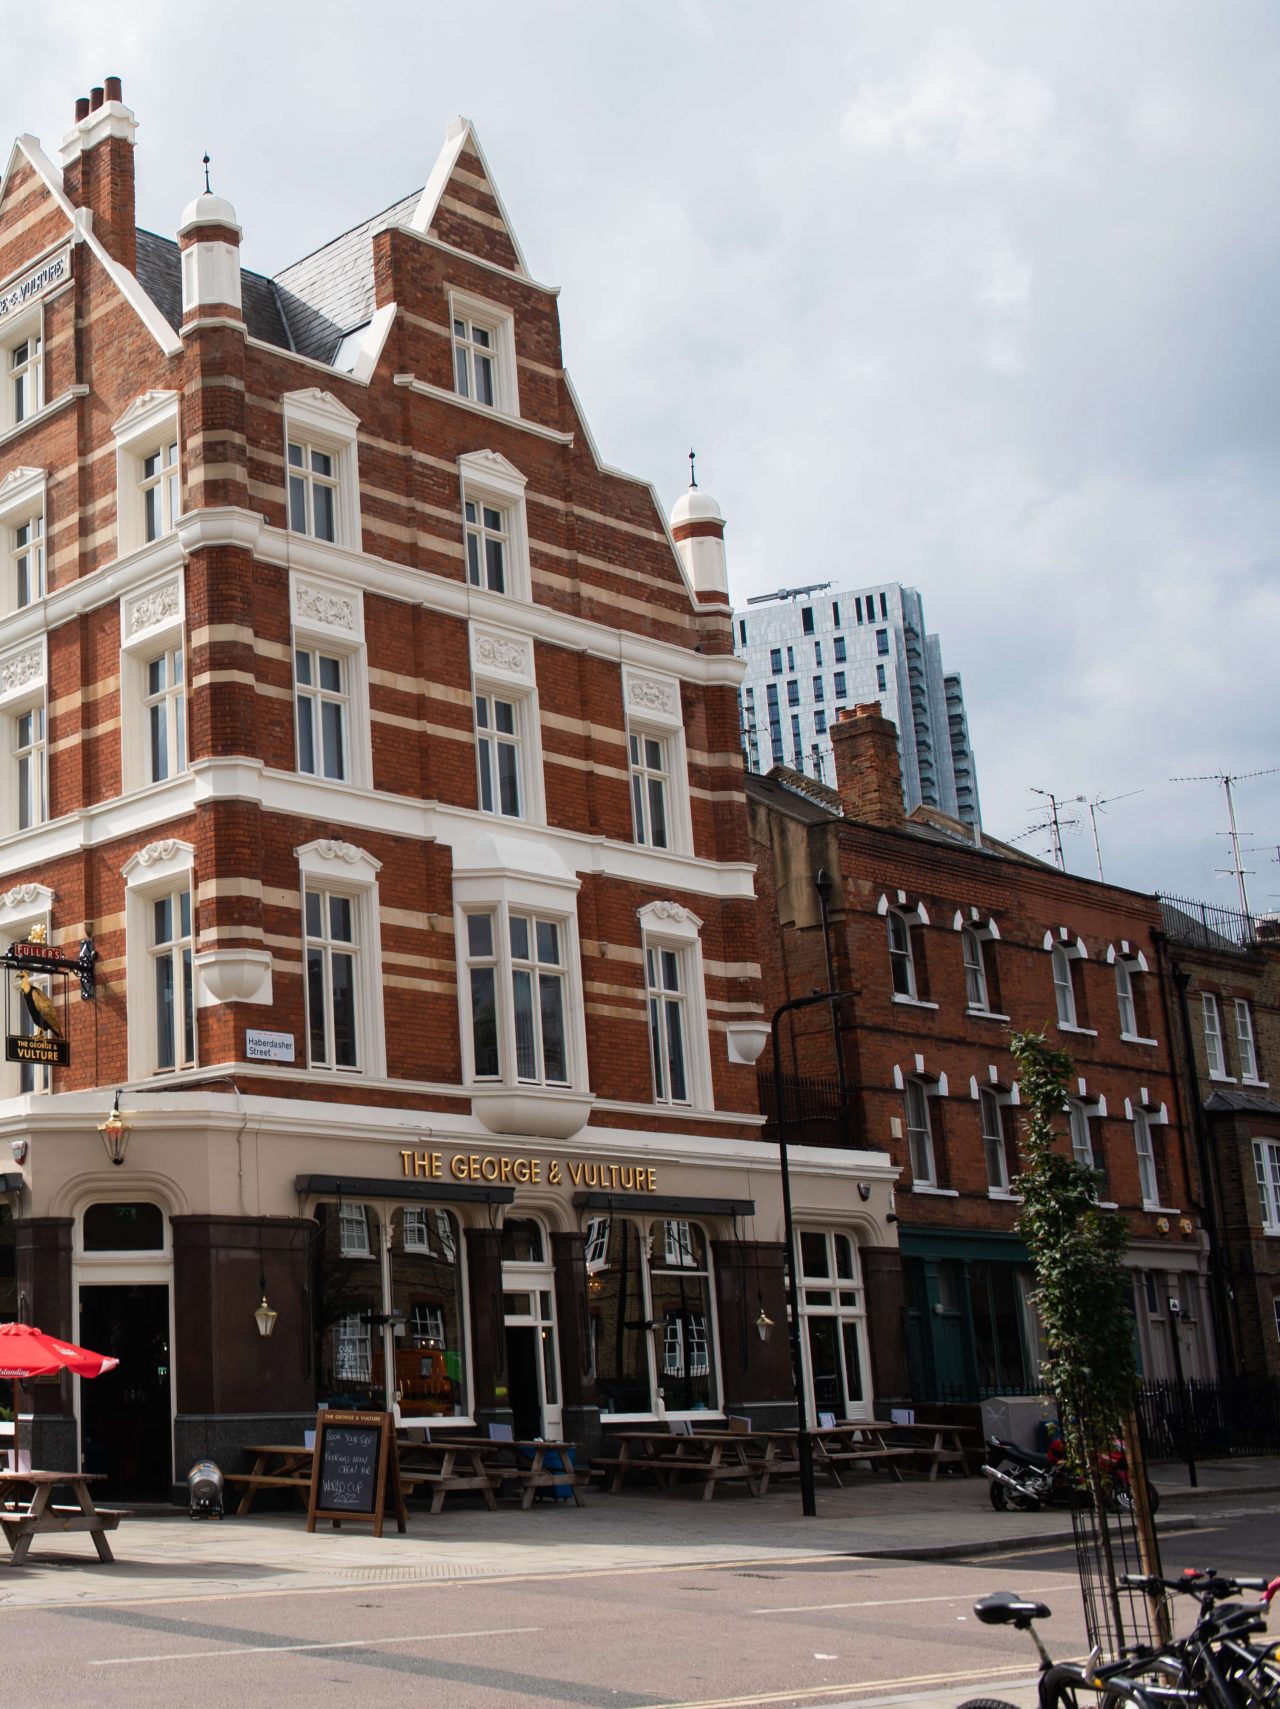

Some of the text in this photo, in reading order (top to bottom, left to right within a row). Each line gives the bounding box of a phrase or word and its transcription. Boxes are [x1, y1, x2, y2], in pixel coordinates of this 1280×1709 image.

[19, 258, 64, 301] VULTURE
[17, 1040, 28, 1048] THE
[29, 1041, 52, 1050] GEORGE
[248, 1036, 293, 1050] Haberdasher
[17, 1048, 59, 1061] VULTURE
[249, 1046, 272, 1057] Street
[400, 1150, 657, 1191] THE GEORGE & VULTURE
[346, 1481, 363, 1495] CUP
[332, 1492, 358, 1503] 2022
